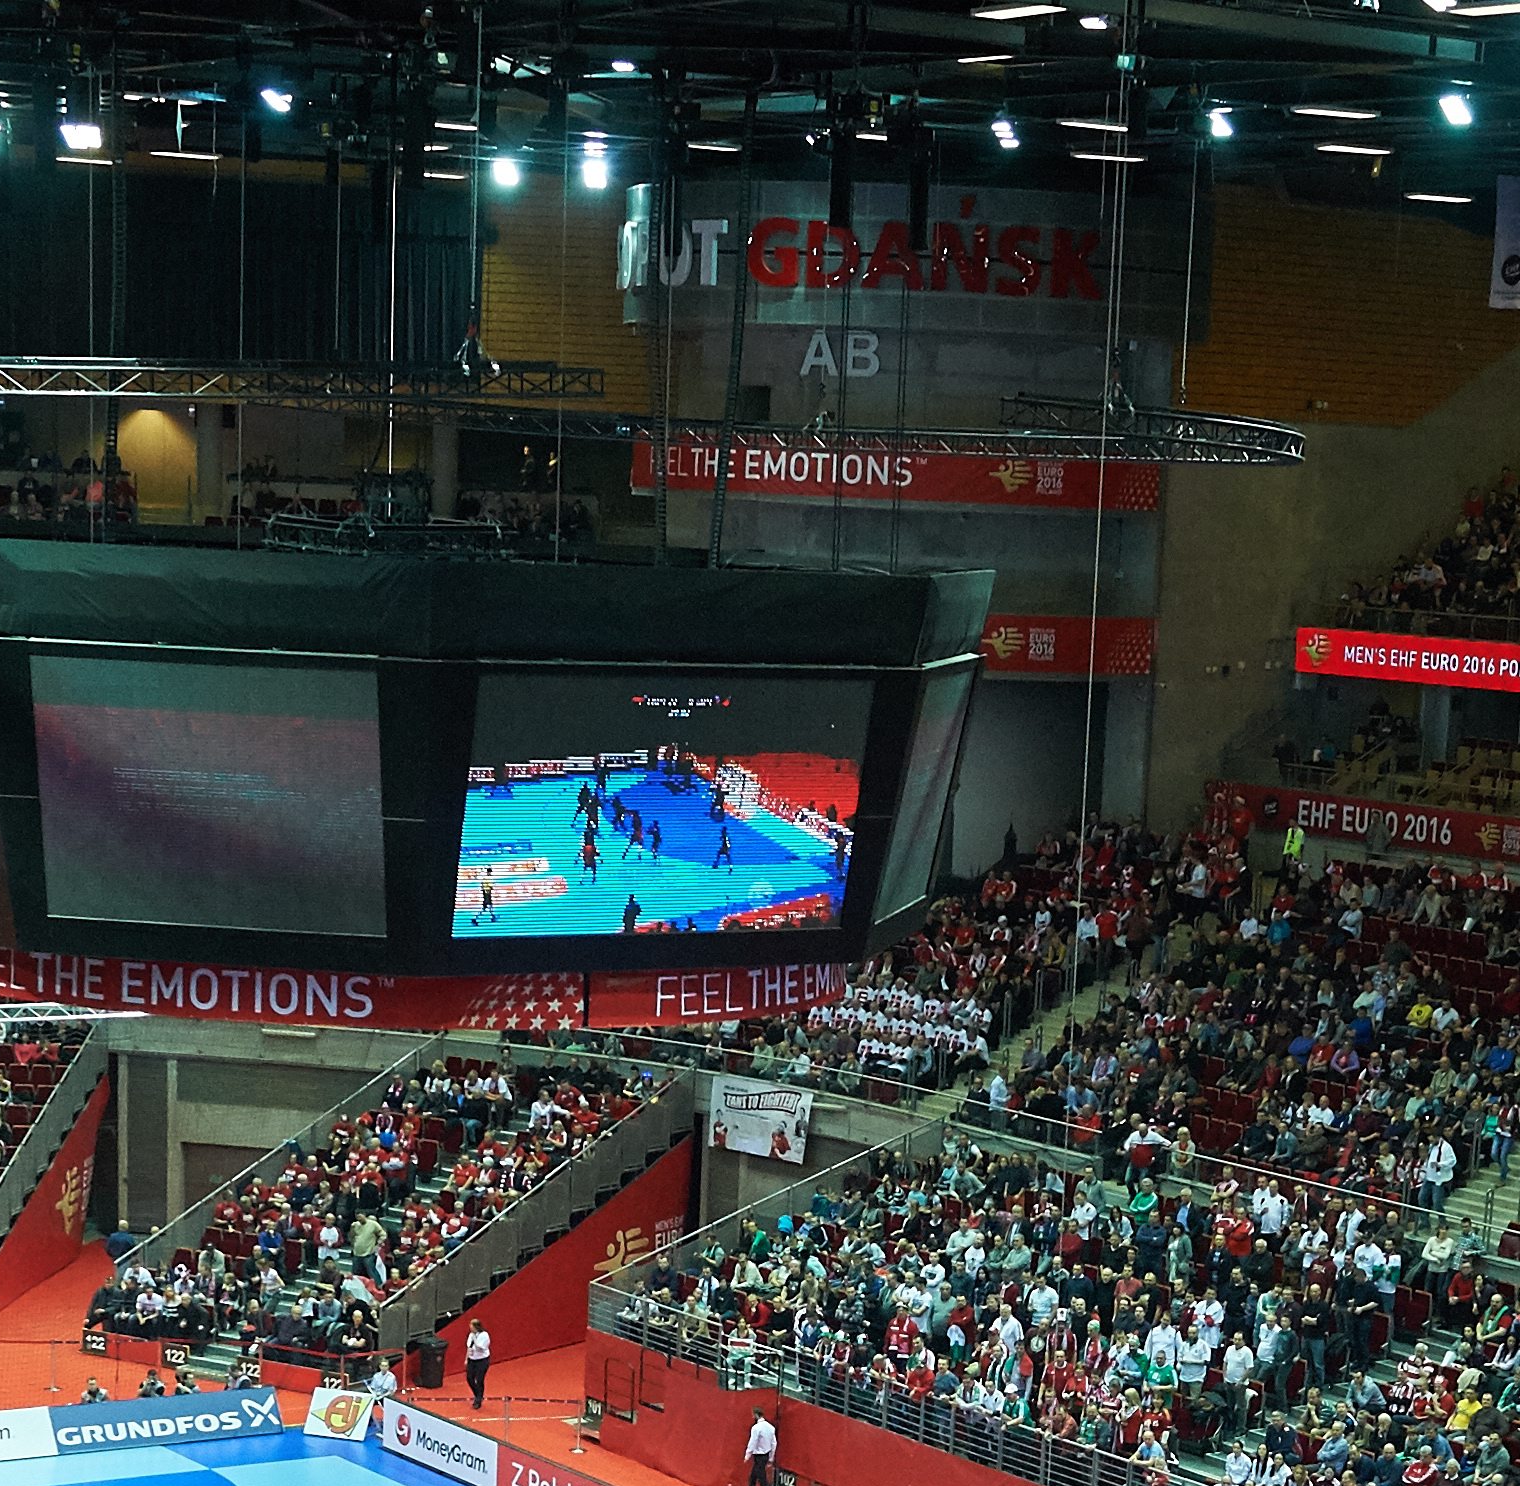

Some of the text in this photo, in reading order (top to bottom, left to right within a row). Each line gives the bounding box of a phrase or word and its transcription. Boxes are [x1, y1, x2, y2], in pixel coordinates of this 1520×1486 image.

[747, 198, 1102, 300] GDAŃSK
[800, 329, 880, 377] AB
[1037, 477, 1063, 488] 2016
[1343, 645, 1385, 665] MEN'S
[1391, 648, 1418, 668] EHF
[1421, 650, 1459, 672] EURO
[1463, 653, 1496, 675] 2016
[1297, 799, 1335, 829] EHF
[1403, 814, 1453, 846] 2016
[31, 953, 106, 999] THE
[656, 974, 744, 1018] FEEL
[748, 966, 798, 1008] THE
[165, 1348, 185, 1363] 122
[240, 1361, 260, 1378] 122
[56, 1410, 242, 1447] GRUNDFOS
[416, 1430, 485, 1475] MoneyGram
